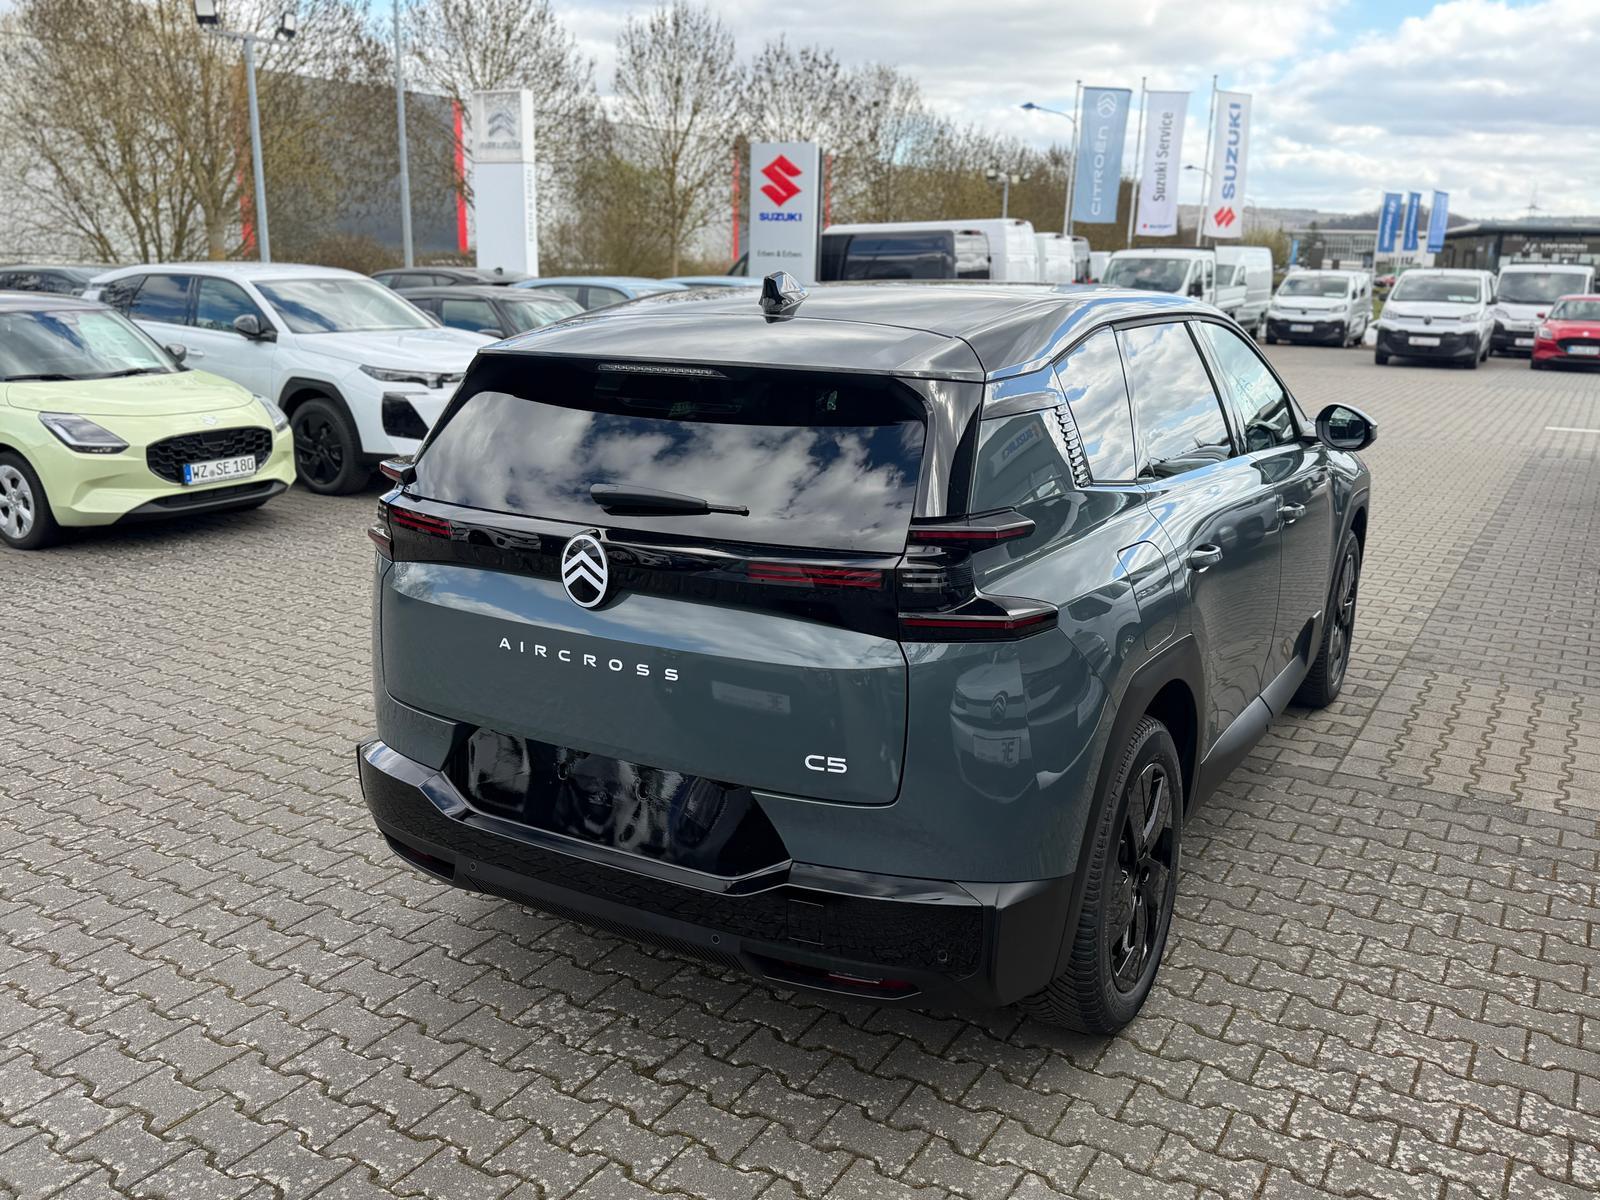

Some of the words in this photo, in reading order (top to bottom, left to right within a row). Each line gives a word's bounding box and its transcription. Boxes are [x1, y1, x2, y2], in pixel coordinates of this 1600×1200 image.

[1156, 111, 1174, 159] Service
[1221, 103, 1241, 199] SUZUKI
[1153, 161, 1168, 202] Suzuki
[759, 212, 802, 221] SUZUKI
[192, 464, 208, 479] WZ
[216, 461, 231, 476] SE
[234, 458, 255, 473] 180
[499, 637, 679, 682] AIRCROSS
[804, 754, 848, 774] C5
